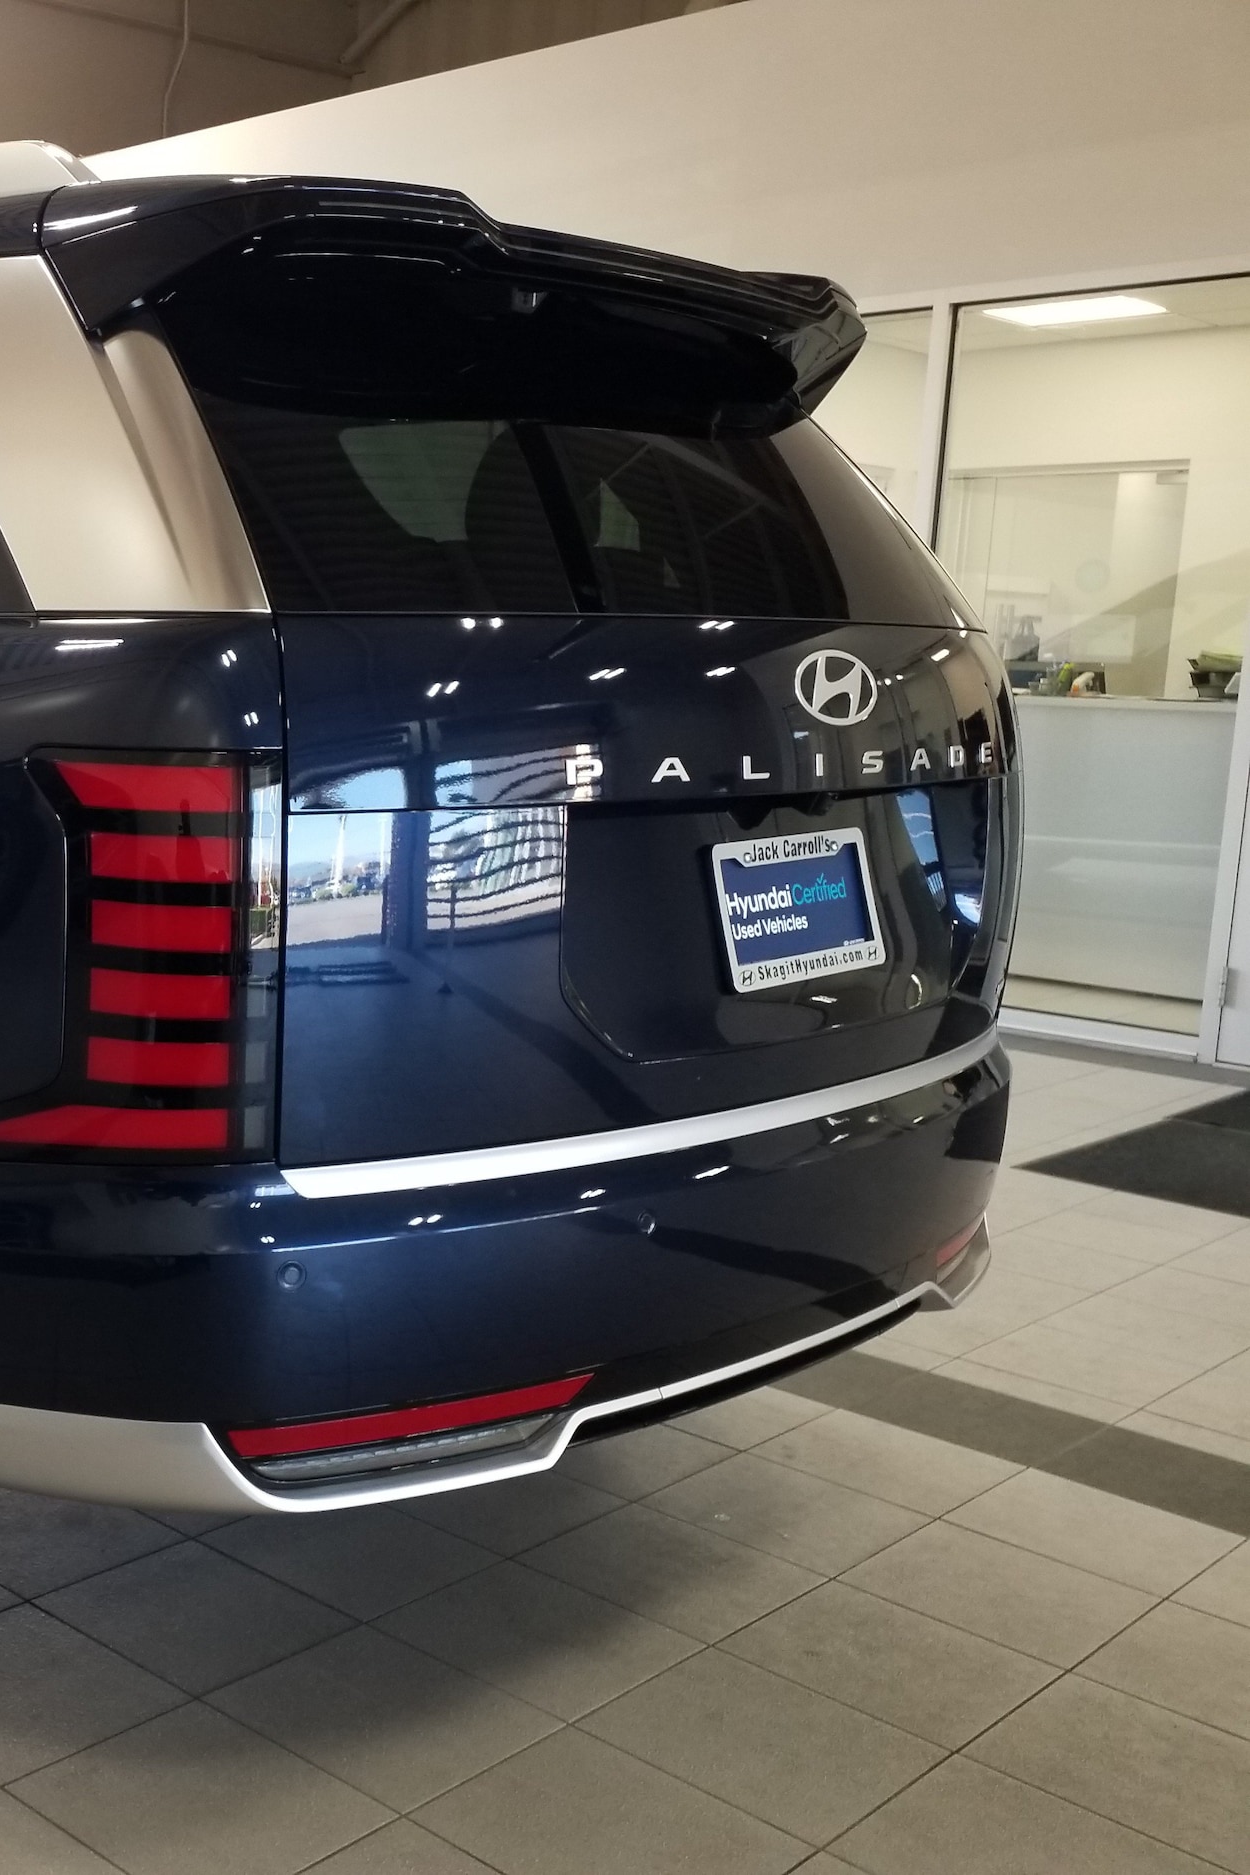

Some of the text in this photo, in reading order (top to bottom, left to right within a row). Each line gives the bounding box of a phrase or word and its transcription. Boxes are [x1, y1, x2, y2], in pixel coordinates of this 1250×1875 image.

[565, 742, 993, 785] PALISADE
[751, 836, 831, 862] Jack Carroll's
[725, 873, 847, 919] Hyundai Certified
[731, 914, 808, 940] Used Vehicles
[757, 949, 863, 980] SkagitHyundai.com
